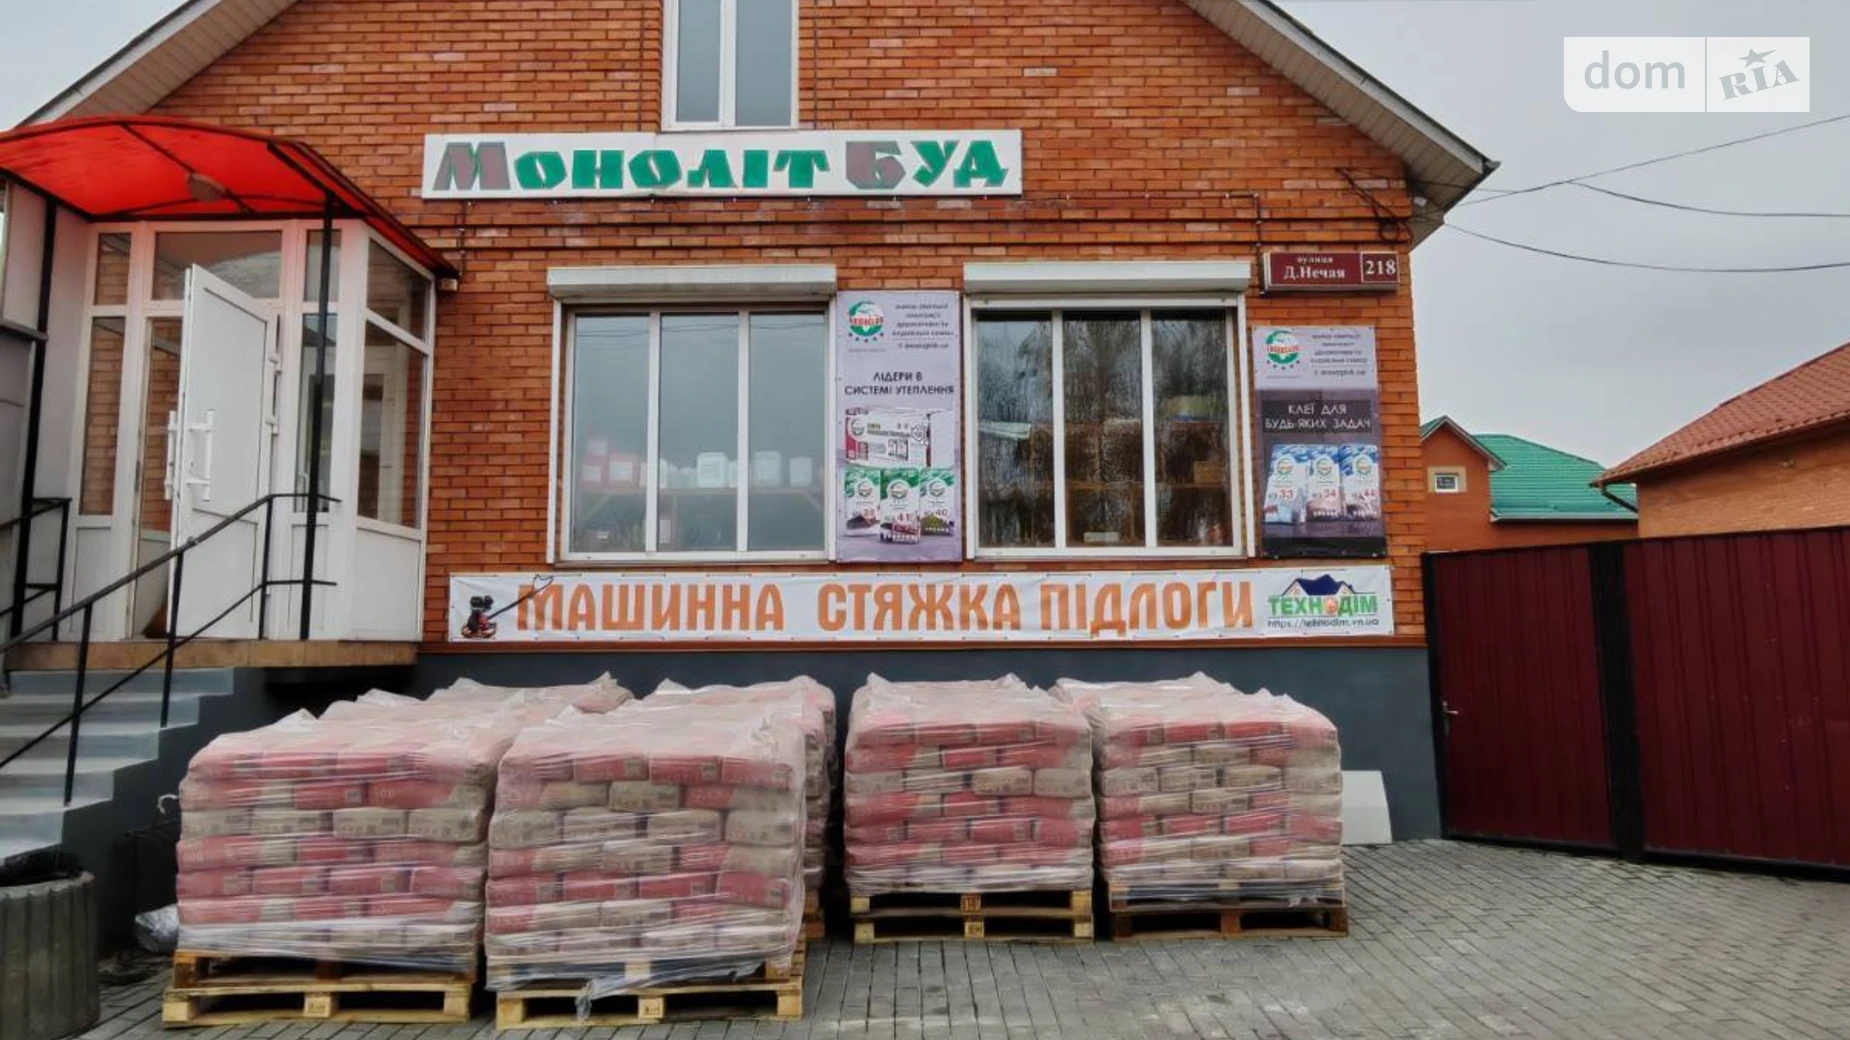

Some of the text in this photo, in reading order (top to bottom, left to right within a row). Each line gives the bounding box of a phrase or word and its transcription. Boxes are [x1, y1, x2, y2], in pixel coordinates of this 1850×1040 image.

[845, 140, 1009, 190] БУД
[1283, 266, 1346, 280] Д.Нечая
[1365, 259, 1396, 275] 218
[873, 371, 923, 382] ЛІДЕРИ В
[844, 385, 955, 396] СИСТЕМІ УТЕПЛЕННЯ
[1320, 403, 1347, 415] ДЛЯ
[1333, 418, 1371, 430] ЗАДАЧ
[516, 580, 1254, 638] МАШИННА СТЯЖКА ПІДЛОГИ
[1268, 595, 1378, 616] ТЕХНОДІМ
